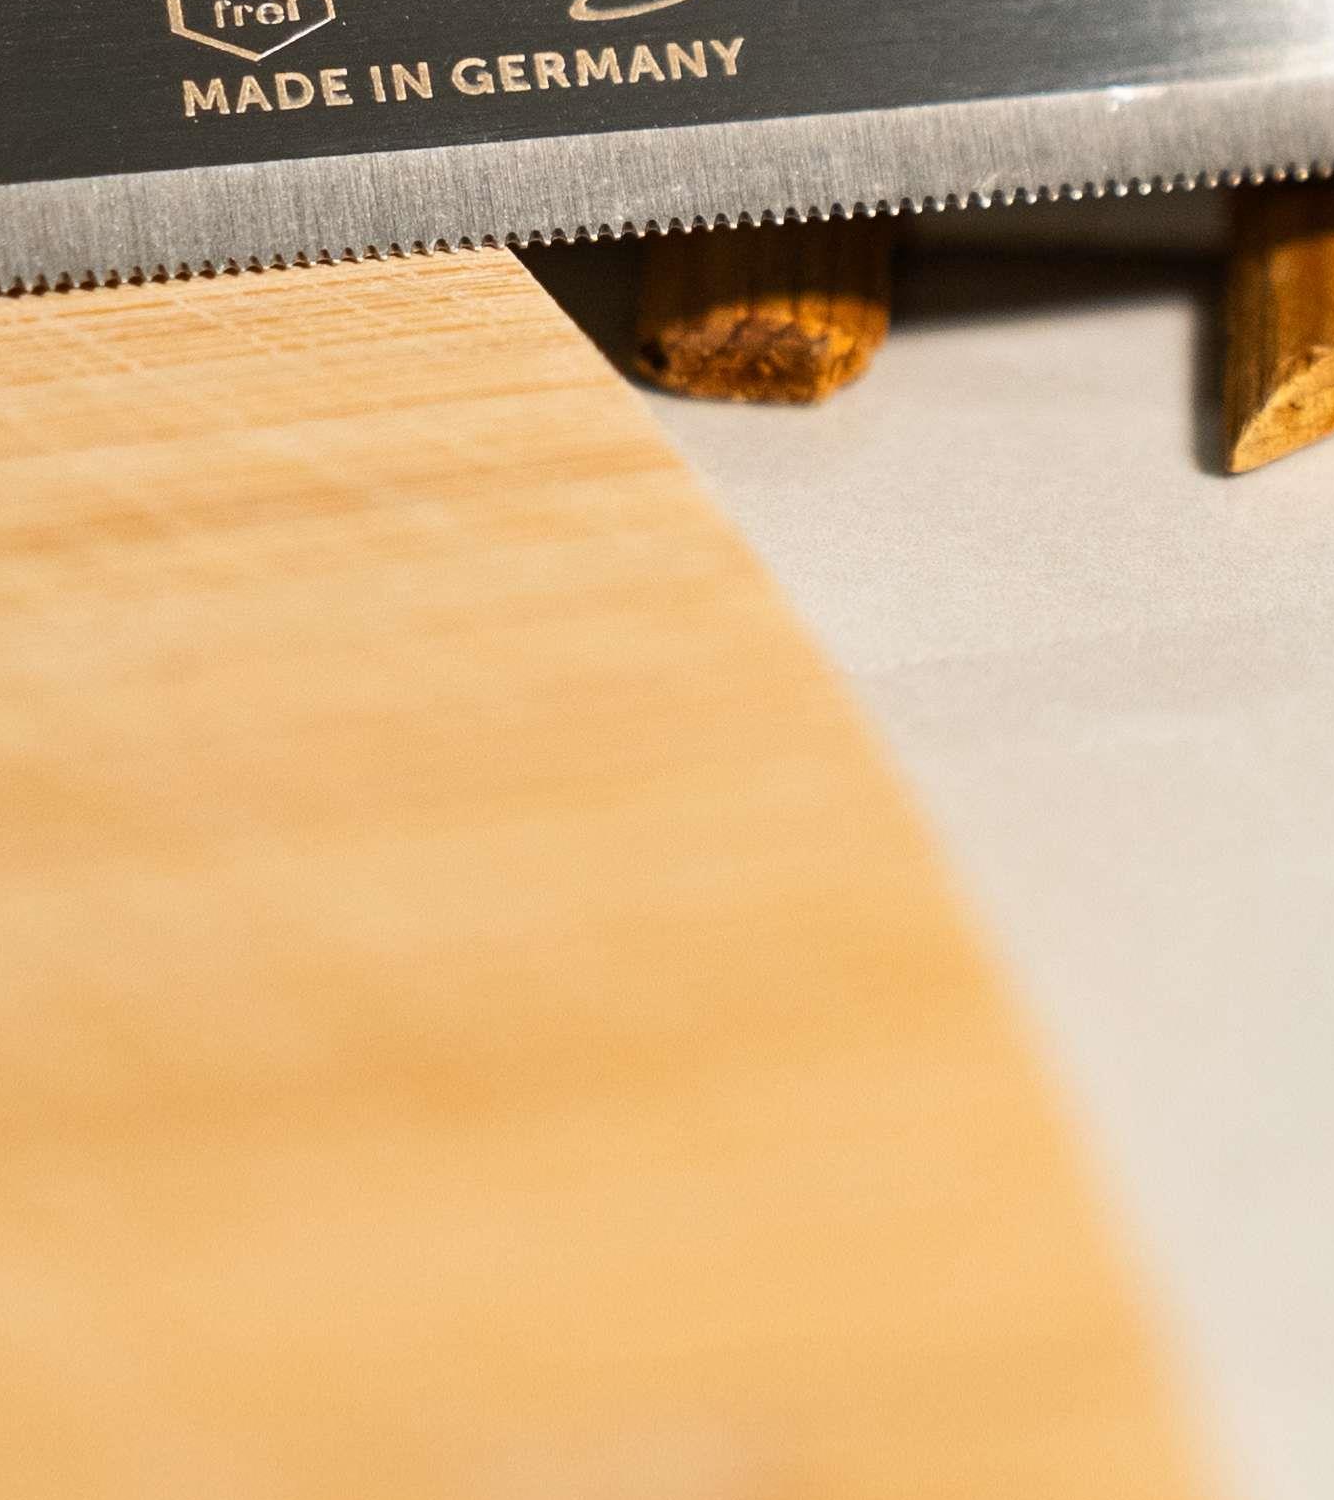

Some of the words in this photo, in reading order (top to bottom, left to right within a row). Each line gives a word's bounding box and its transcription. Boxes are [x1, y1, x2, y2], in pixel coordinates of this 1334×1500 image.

[182, 67, 354, 118] MADE
[369, 61, 433, 103] IN
[450, 36, 745, 96] GERMANY
